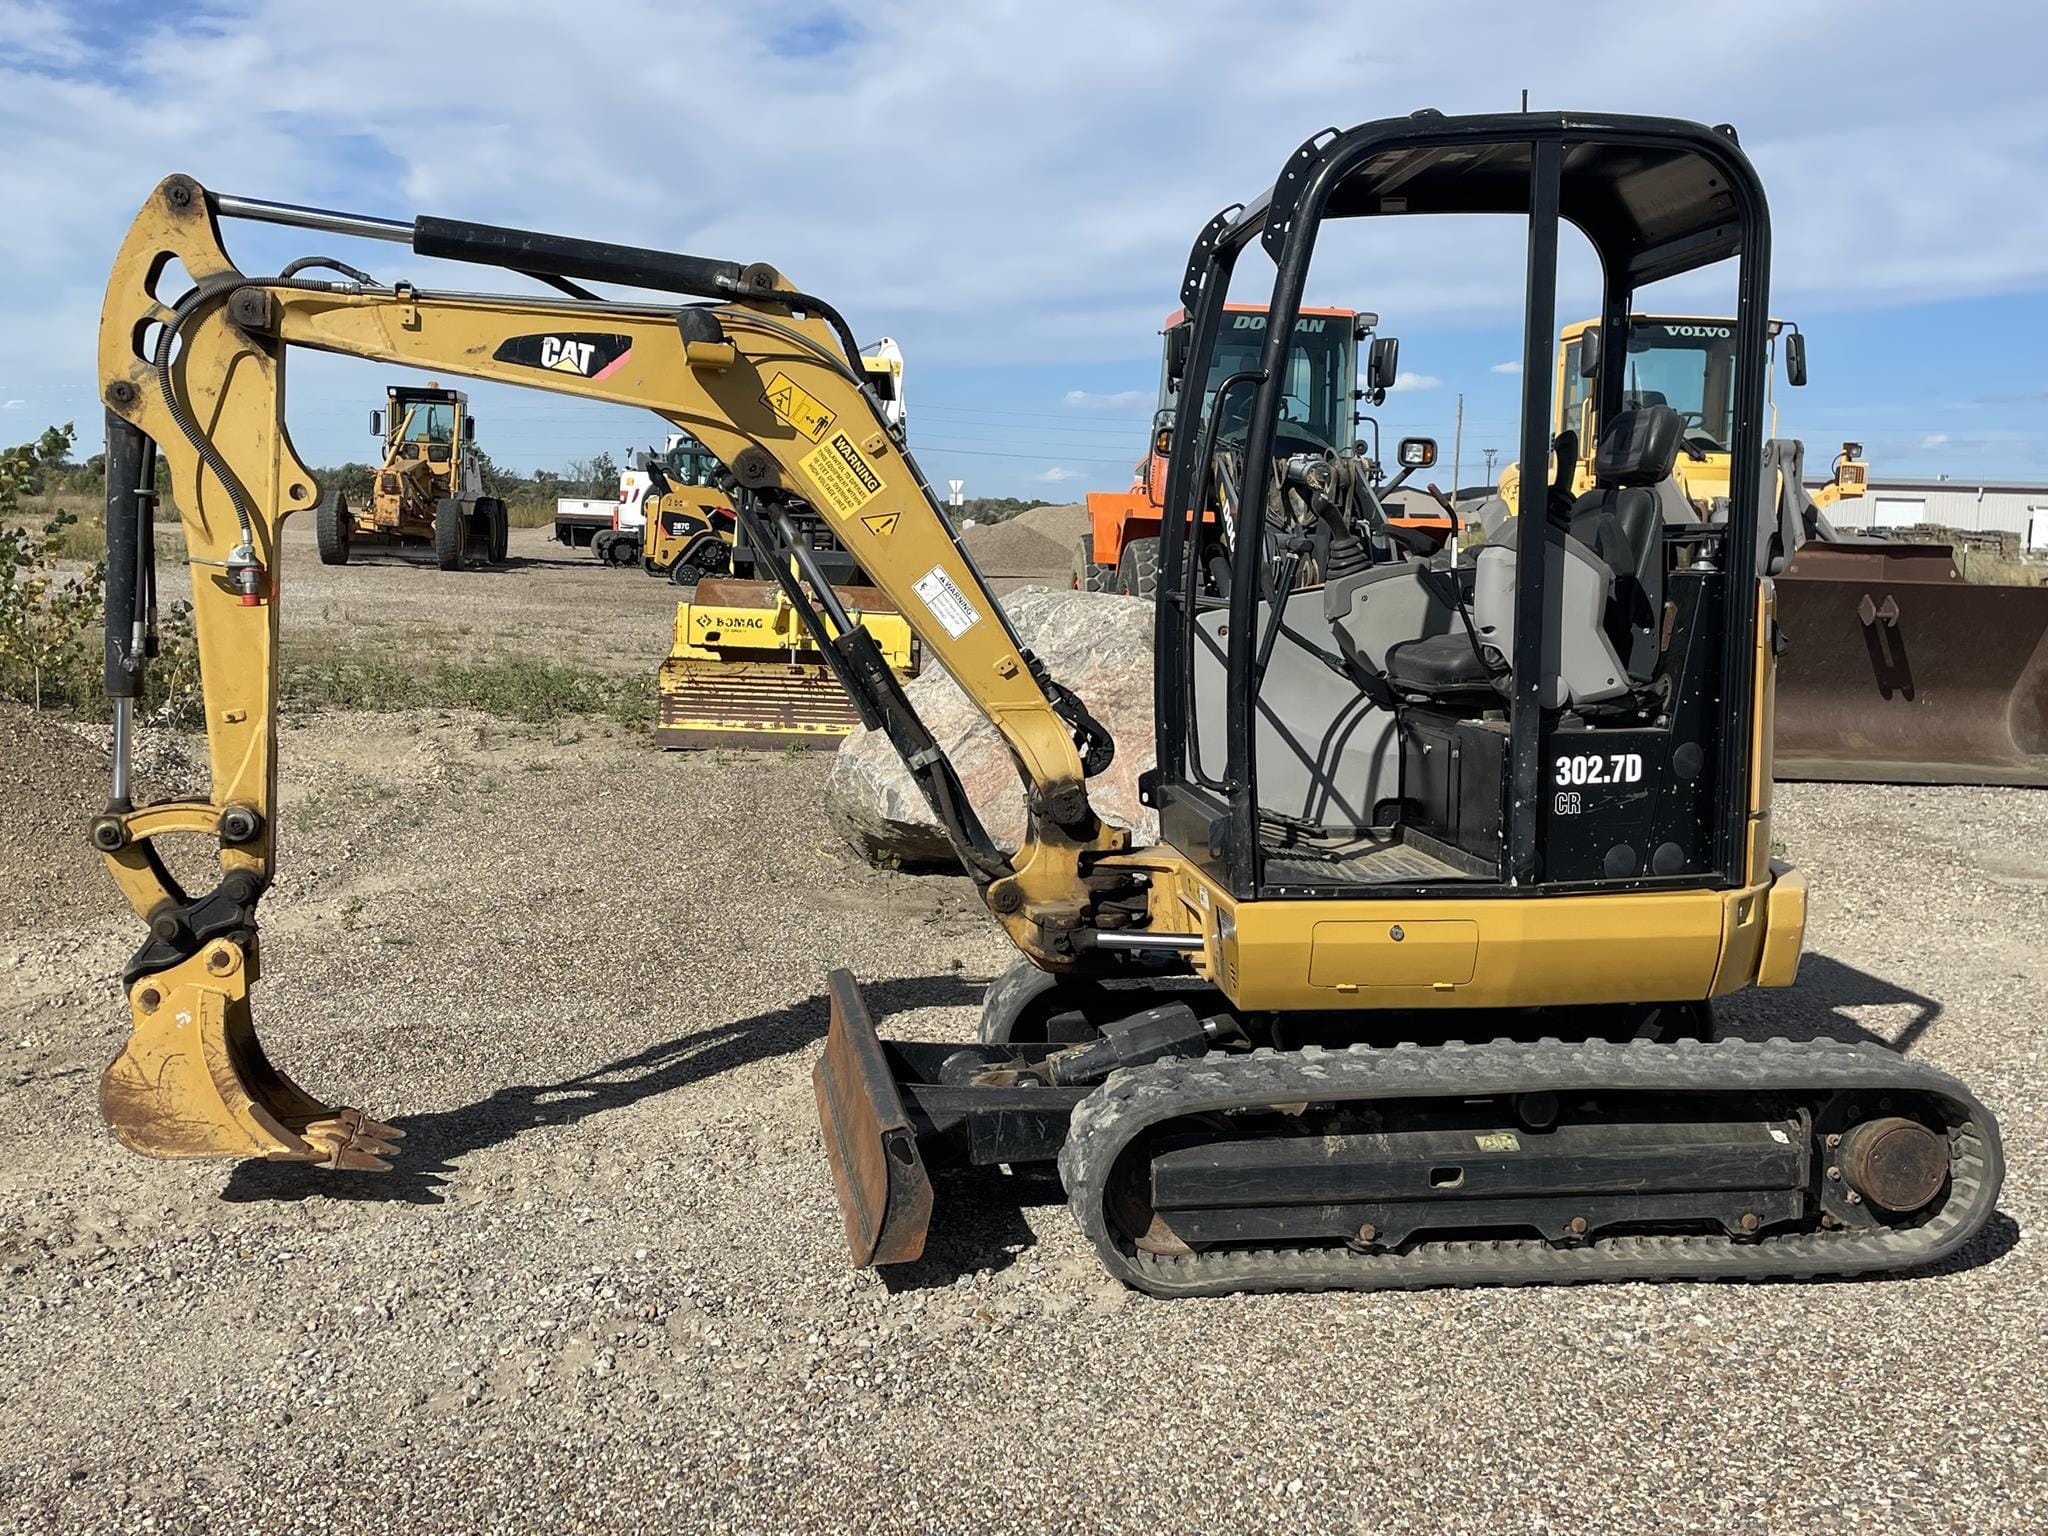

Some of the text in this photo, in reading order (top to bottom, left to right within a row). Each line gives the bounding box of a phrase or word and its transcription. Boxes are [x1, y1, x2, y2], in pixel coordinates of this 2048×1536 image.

[1233, 316, 1326, 333] DOAN
[1664, 325, 1730, 338] VOLVO
[541, 337, 595, 375] CAT
[807, 462, 819, 476] HIGH
[817, 474, 835, 496] VOLTAGE
[816, 449, 862, 506] THIS EQUIPMENT WITHIN
[823, 445, 867, 500] UNLAWFUL TO OPERATE
[833, 436, 879, 491] WARNING
[817, 462, 829, 475] FEET
[826, 474, 834, 483] OF
[832, 481, 854, 508] OVERHEAD
[944, 580, 973, 615] WARNING
[1555, 754, 1642, 786] 302.7D
[1554, 791, 1581, 815] CR
